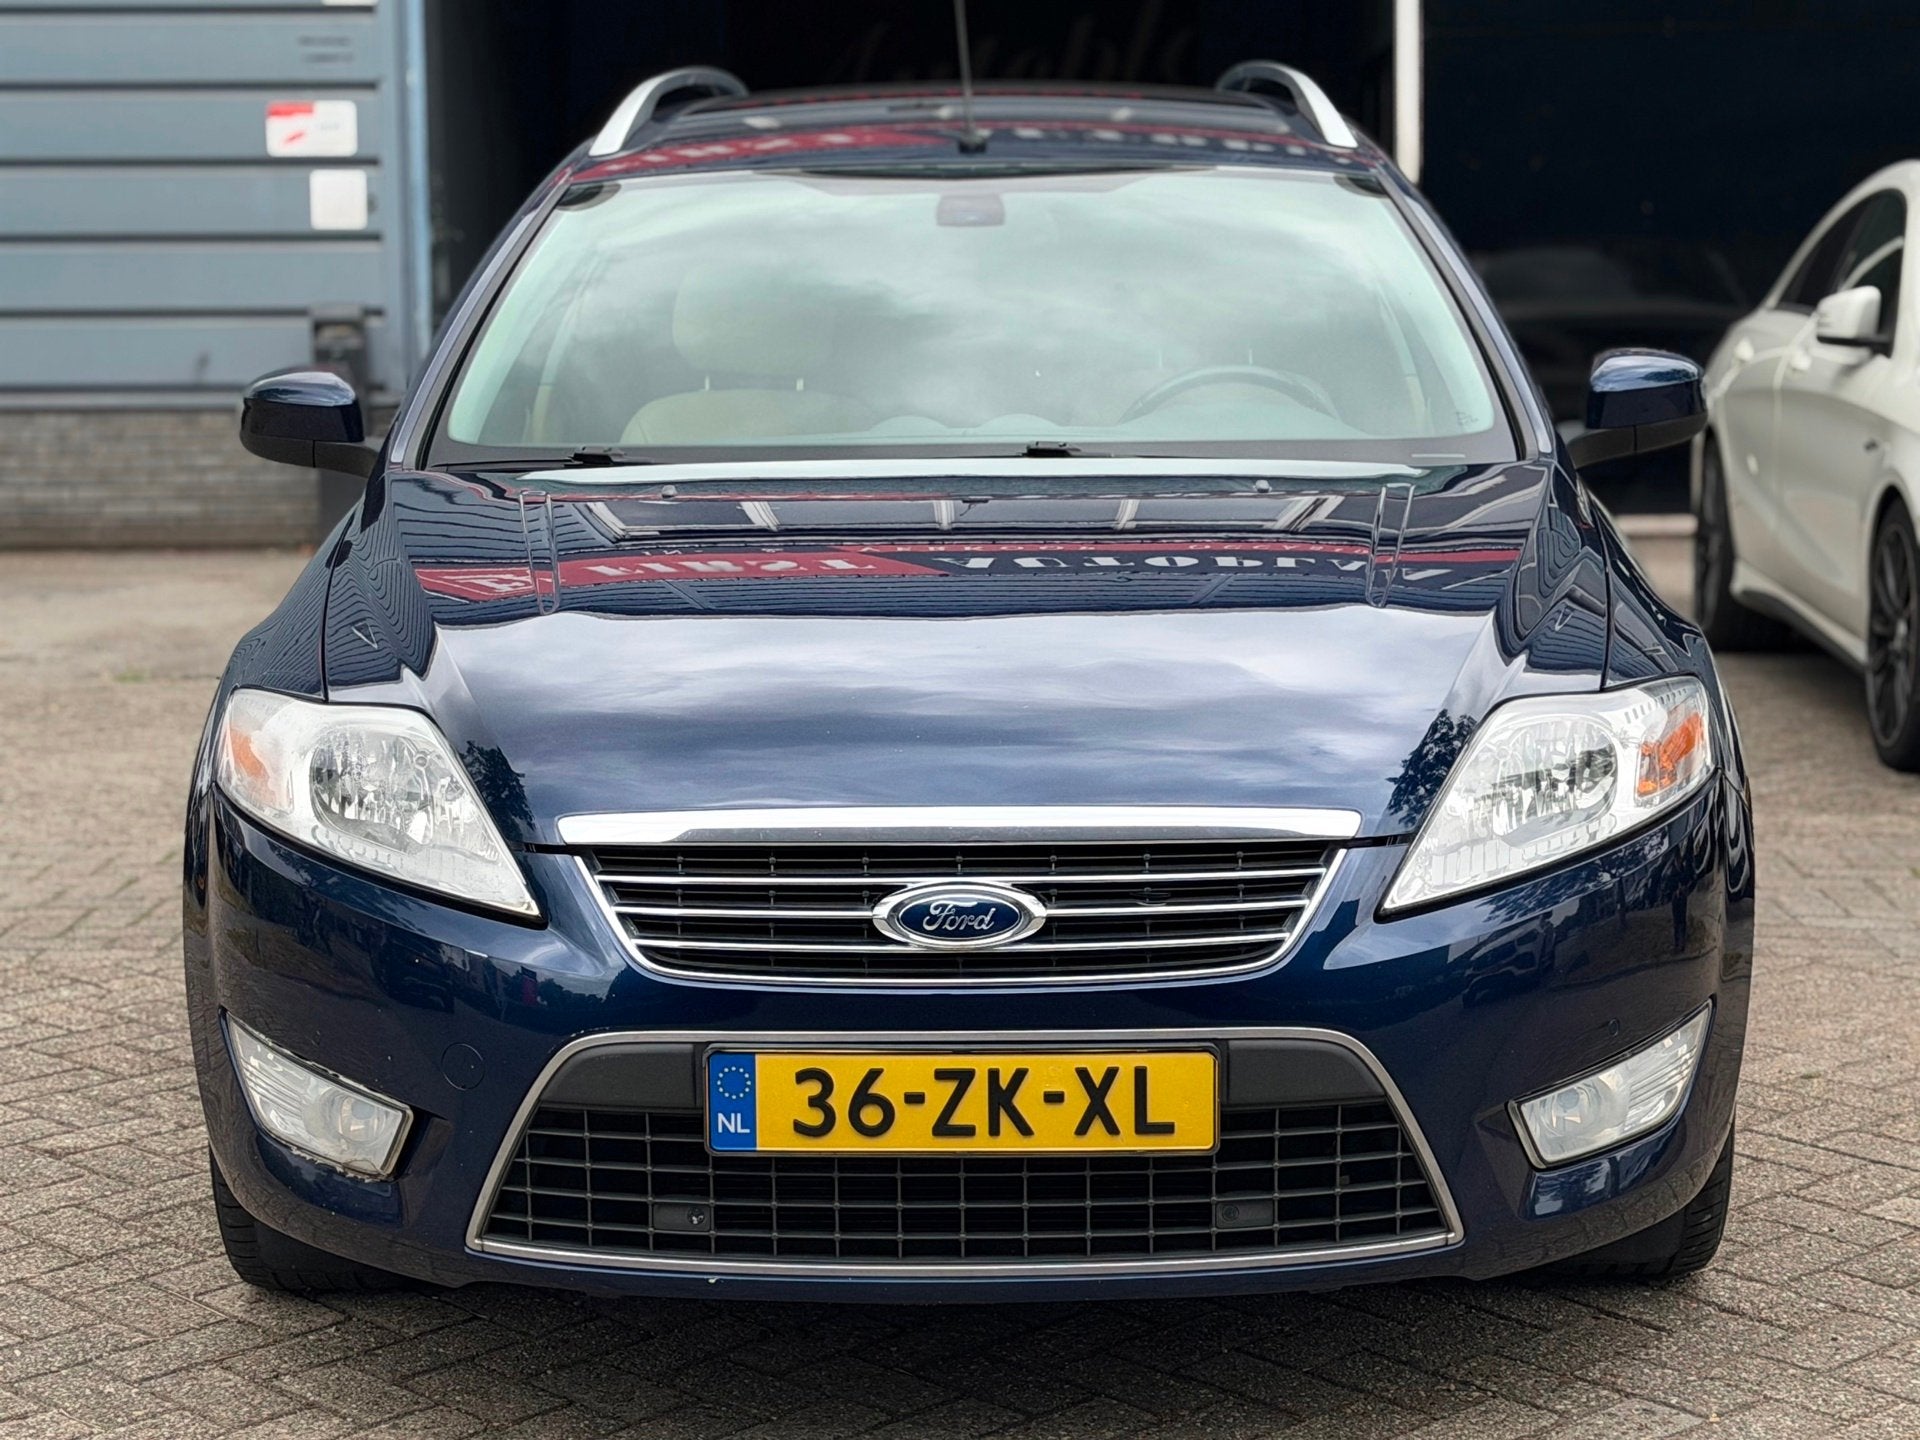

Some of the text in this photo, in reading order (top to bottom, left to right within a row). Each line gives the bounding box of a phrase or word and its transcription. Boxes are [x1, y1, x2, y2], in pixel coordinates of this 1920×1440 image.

[922, 899, 996, 931] Ford
[792, 1066, 1176, 1138] 36-ZK-XL
[717, 1112, 750, 1134] NL
